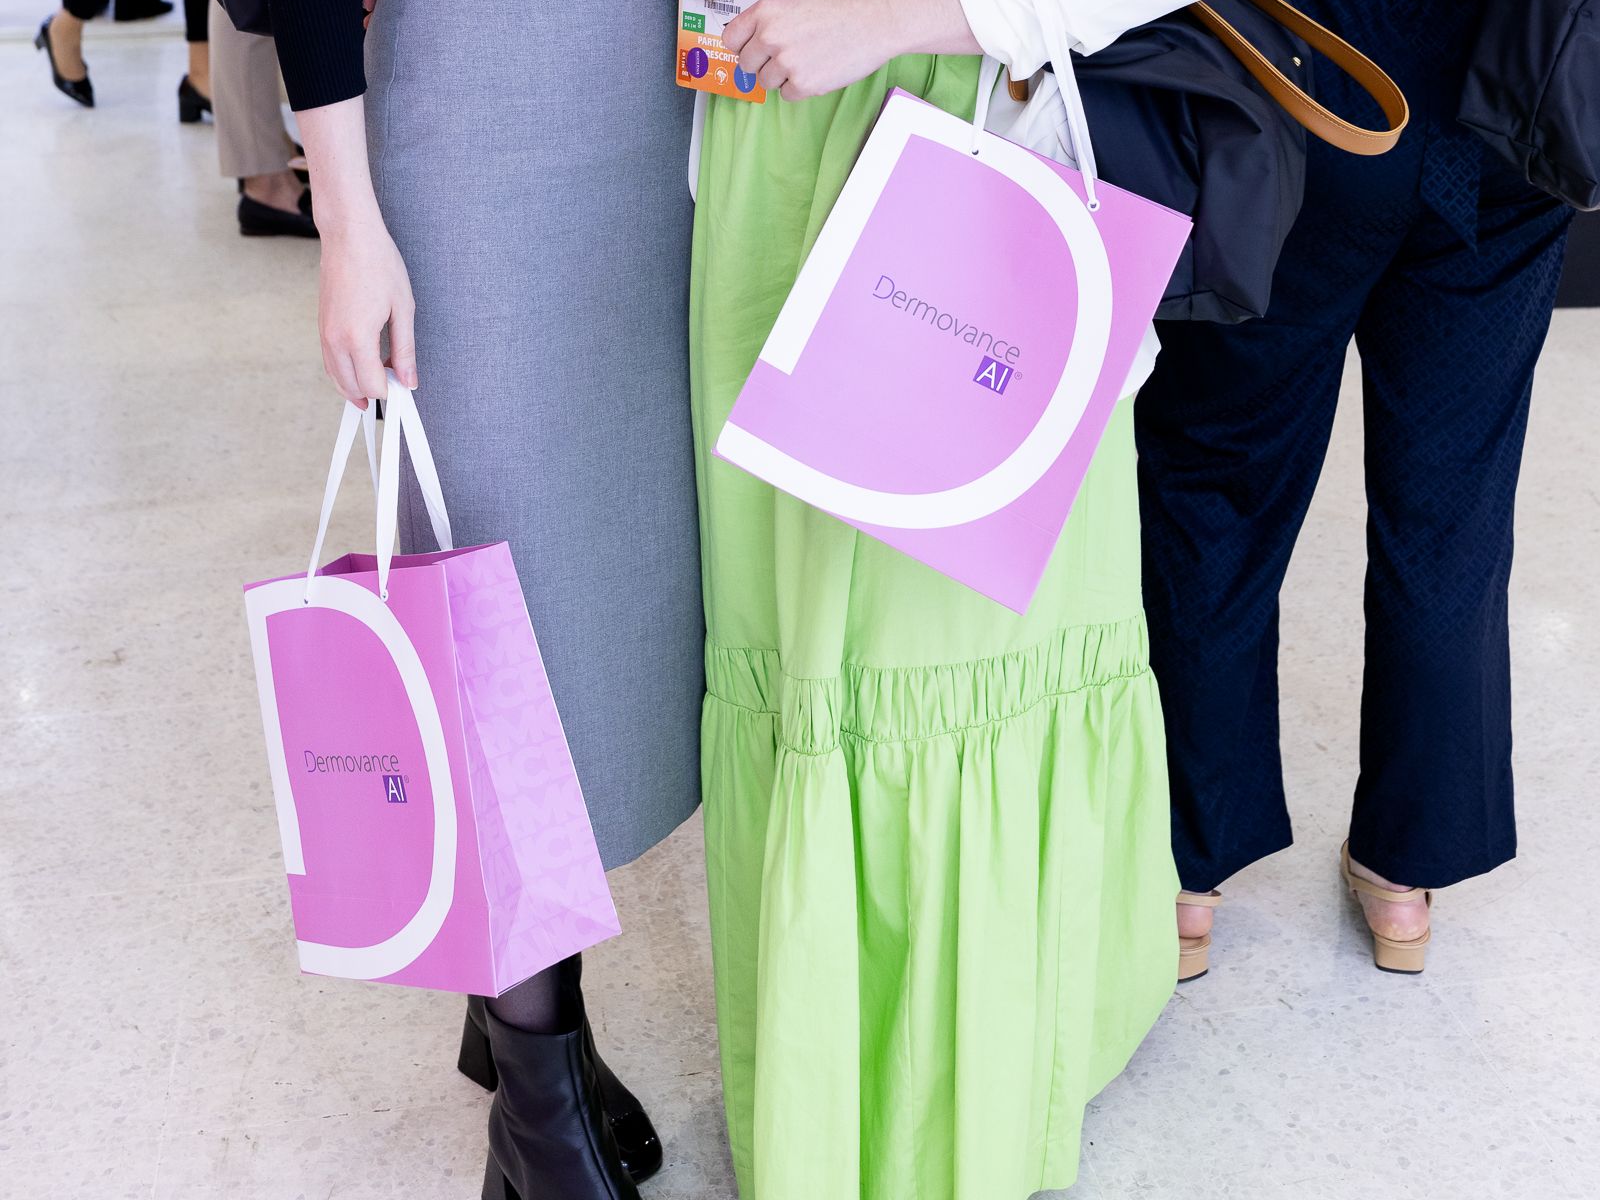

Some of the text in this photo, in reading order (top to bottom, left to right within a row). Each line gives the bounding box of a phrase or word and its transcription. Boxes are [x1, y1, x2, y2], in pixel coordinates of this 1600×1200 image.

[697, 36, 728, 50] PARTIC
[872, 274, 1021, 365] Dermovance
[973, 355, 1014, 395] AI
[303, 750, 401, 773] Dermovance
[383, 775, 407, 803] AI
